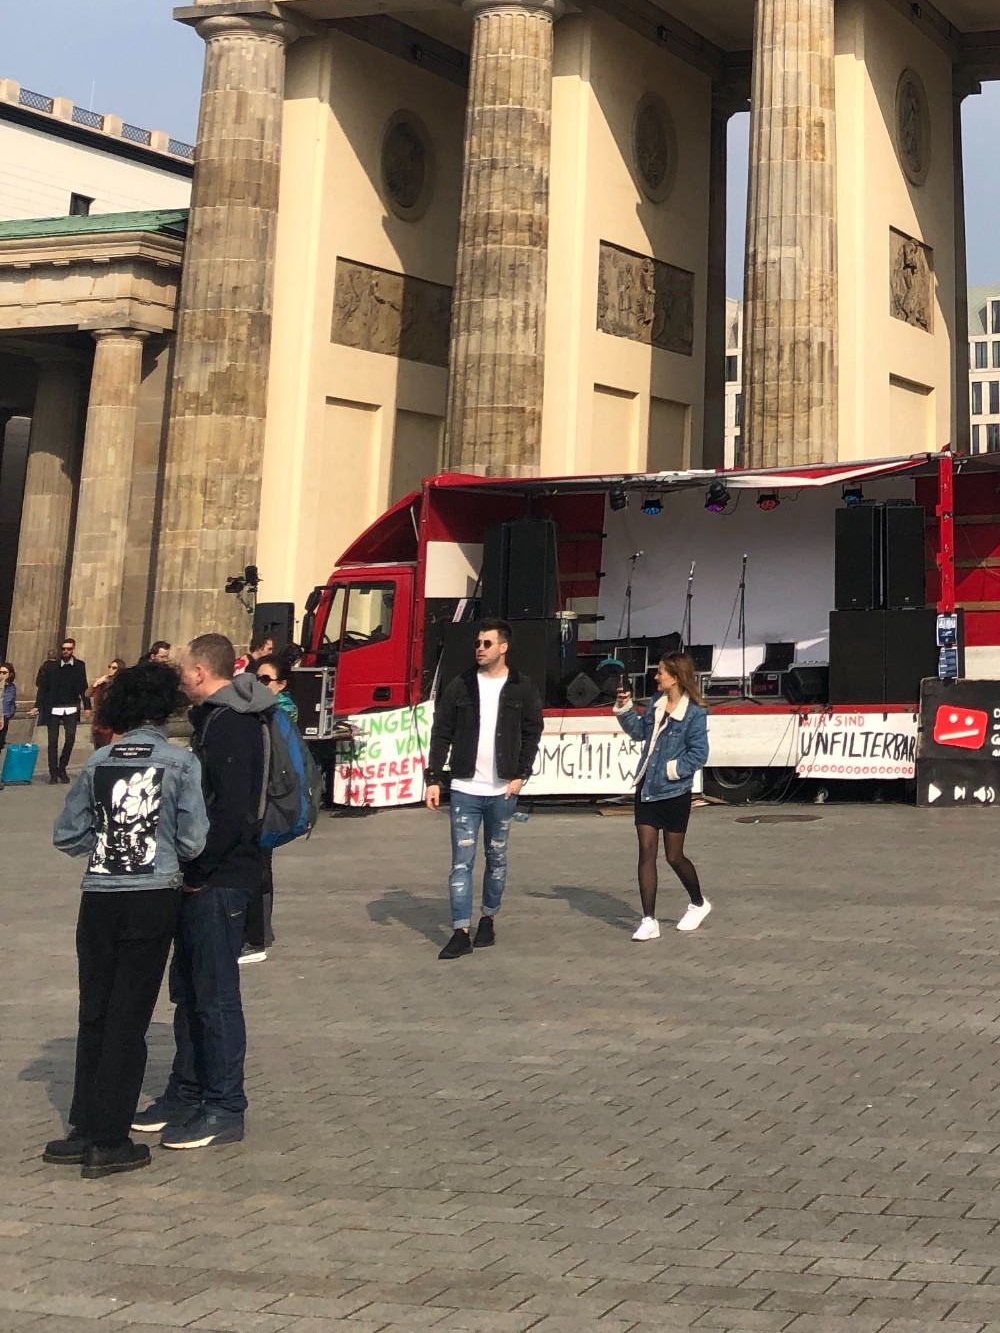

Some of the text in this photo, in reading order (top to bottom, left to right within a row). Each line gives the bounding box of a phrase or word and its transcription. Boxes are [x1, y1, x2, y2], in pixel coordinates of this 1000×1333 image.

[354, 706, 429, 735] INGER
[801, 714, 865, 728] WIR SIND
[395, 731, 428, 756] VON
[801, 731, 916, 763] UNFILTERBAR
[339, 755, 427, 780] UNSEREM
[344, 778, 413, 804] NETZ
